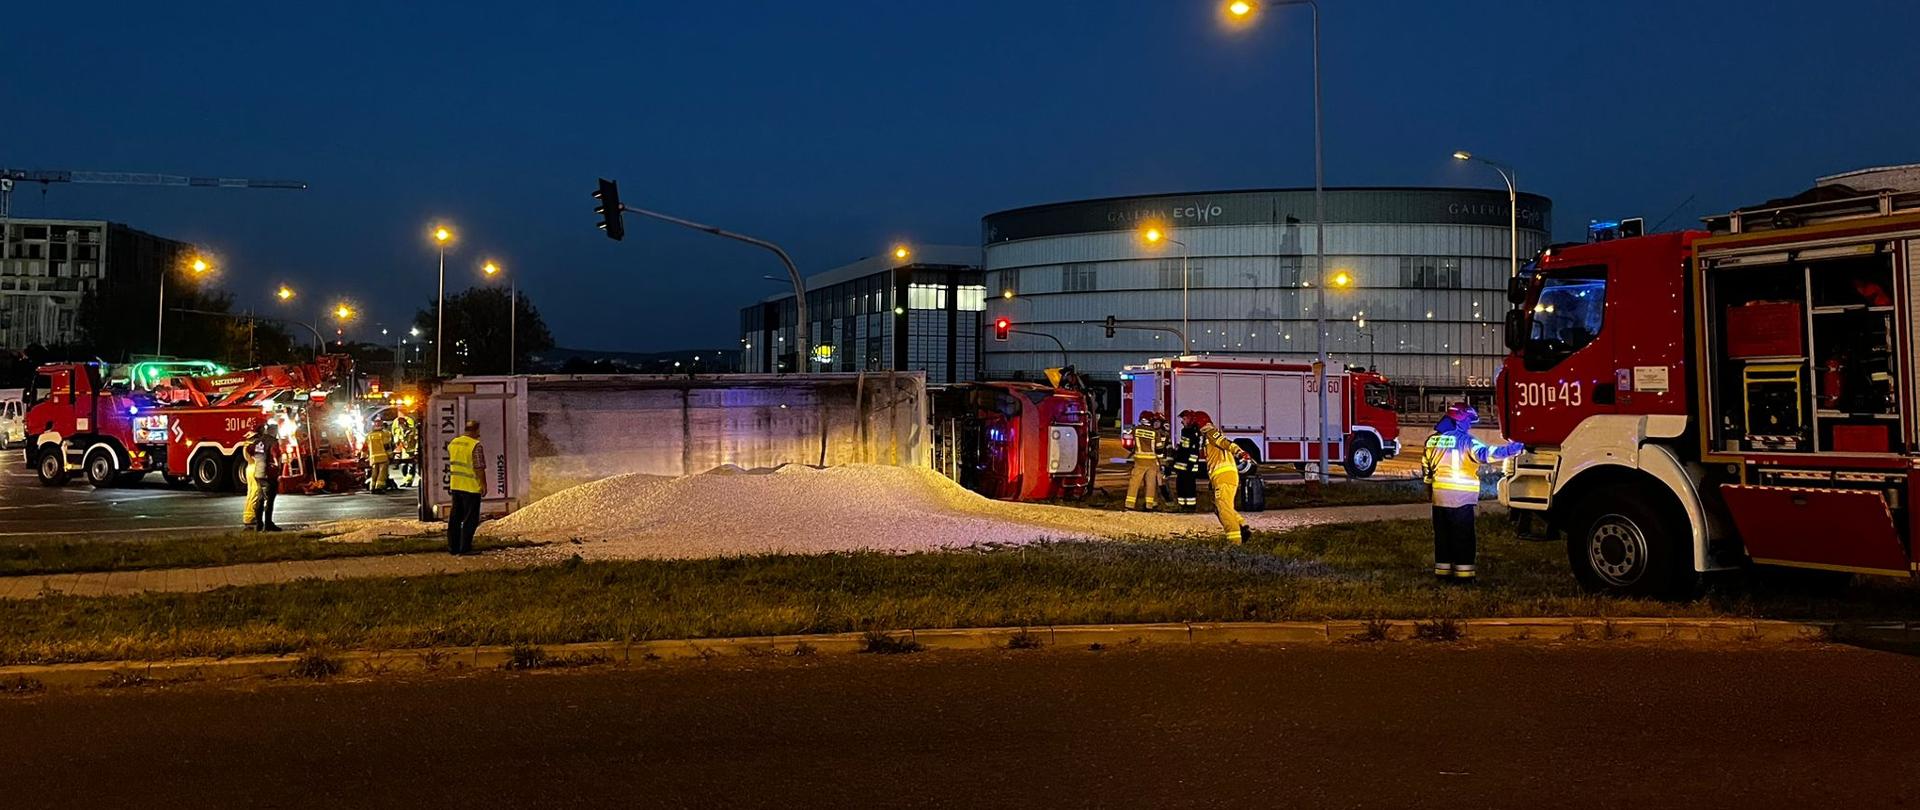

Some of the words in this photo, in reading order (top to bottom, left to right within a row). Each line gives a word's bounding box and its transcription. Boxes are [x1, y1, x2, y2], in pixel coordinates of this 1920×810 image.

[1173, 200, 1222, 223] ECHO
[1448, 203, 1510, 218] GALERIA
[1327, 381, 1340, 393] 60
[1558, 382, 1582, 407] 43
[441, 403, 455, 434] TKI
[497, 454, 505, 495] SCHMITZ
